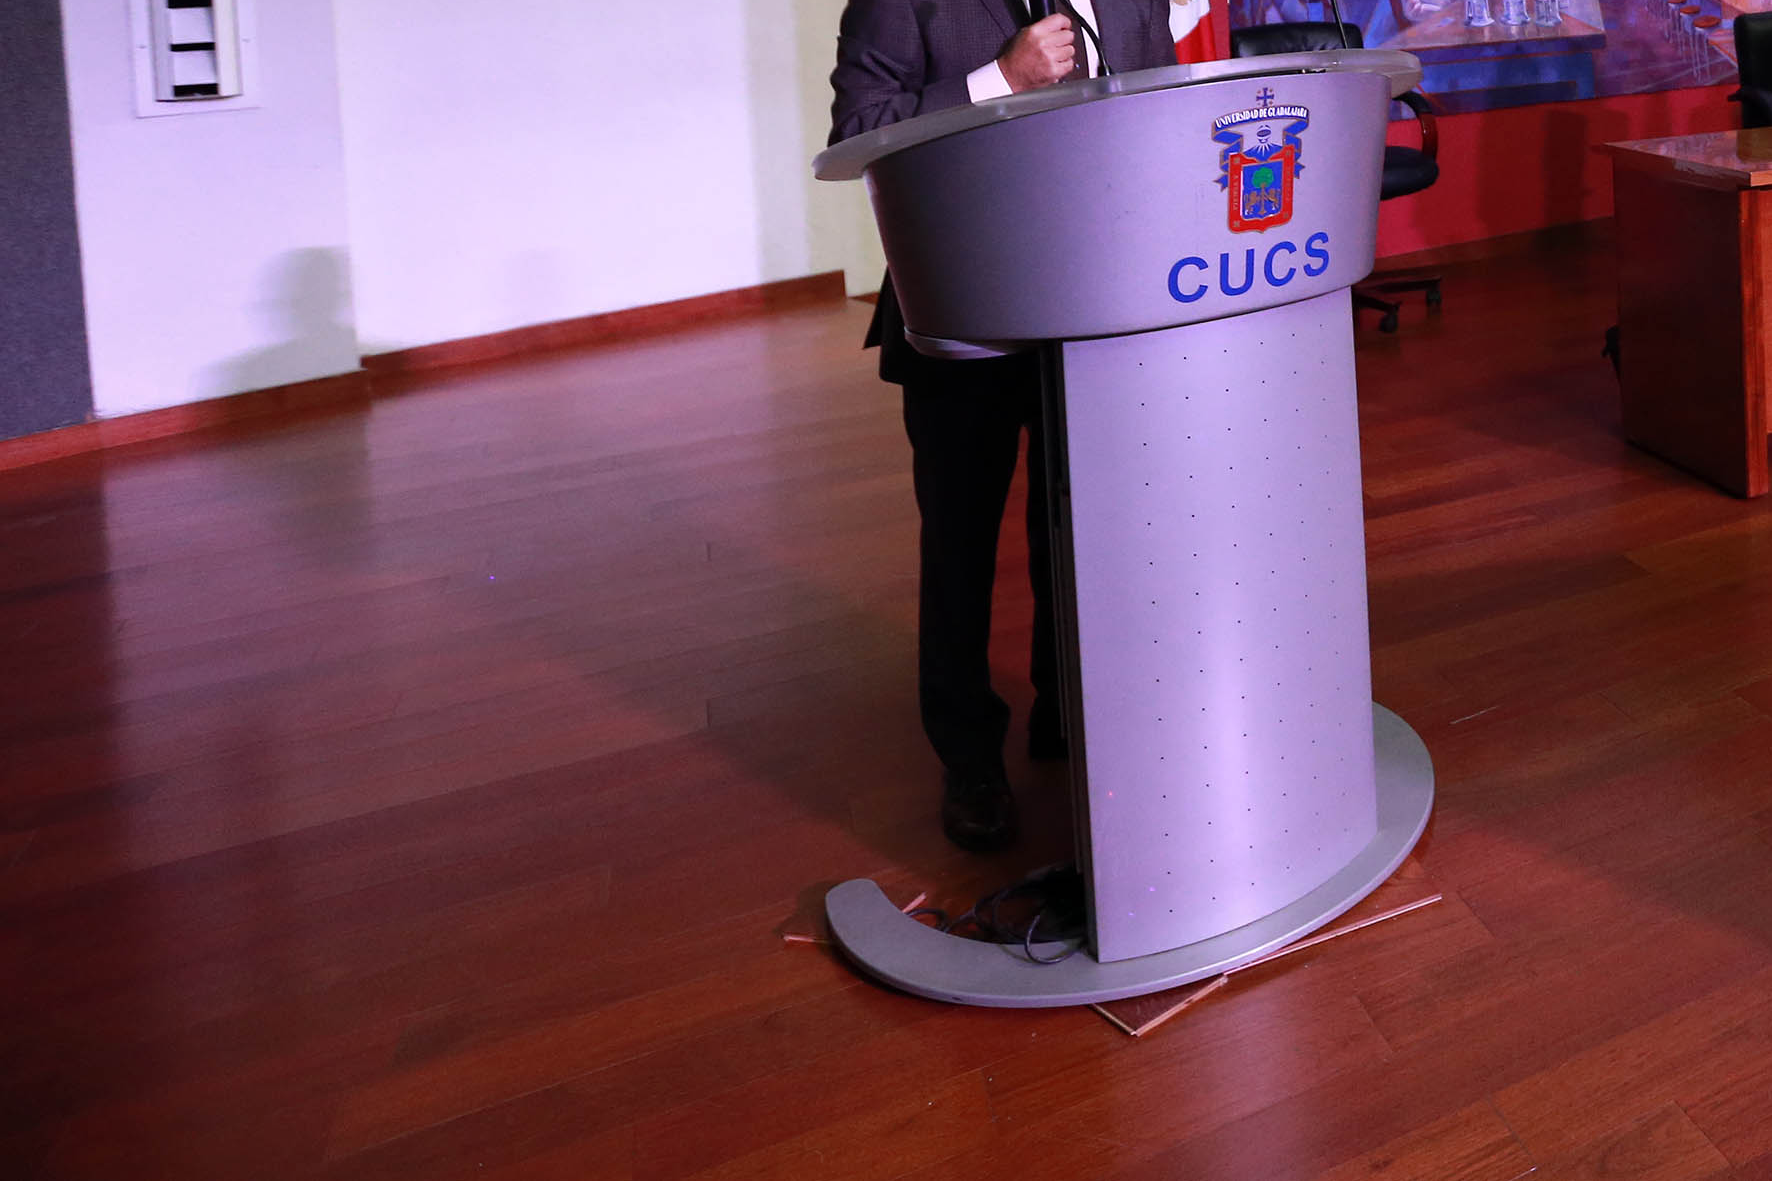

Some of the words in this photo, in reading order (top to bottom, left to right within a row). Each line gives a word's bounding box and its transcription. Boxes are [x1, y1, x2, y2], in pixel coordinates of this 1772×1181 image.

[1215, 108, 1259, 128] UNIVERSIDAD
[1259, 108, 1268, 118] DE
[1267, 106, 1308, 118] GUADALAJARA
[1167, 231, 1330, 303] CUCS
